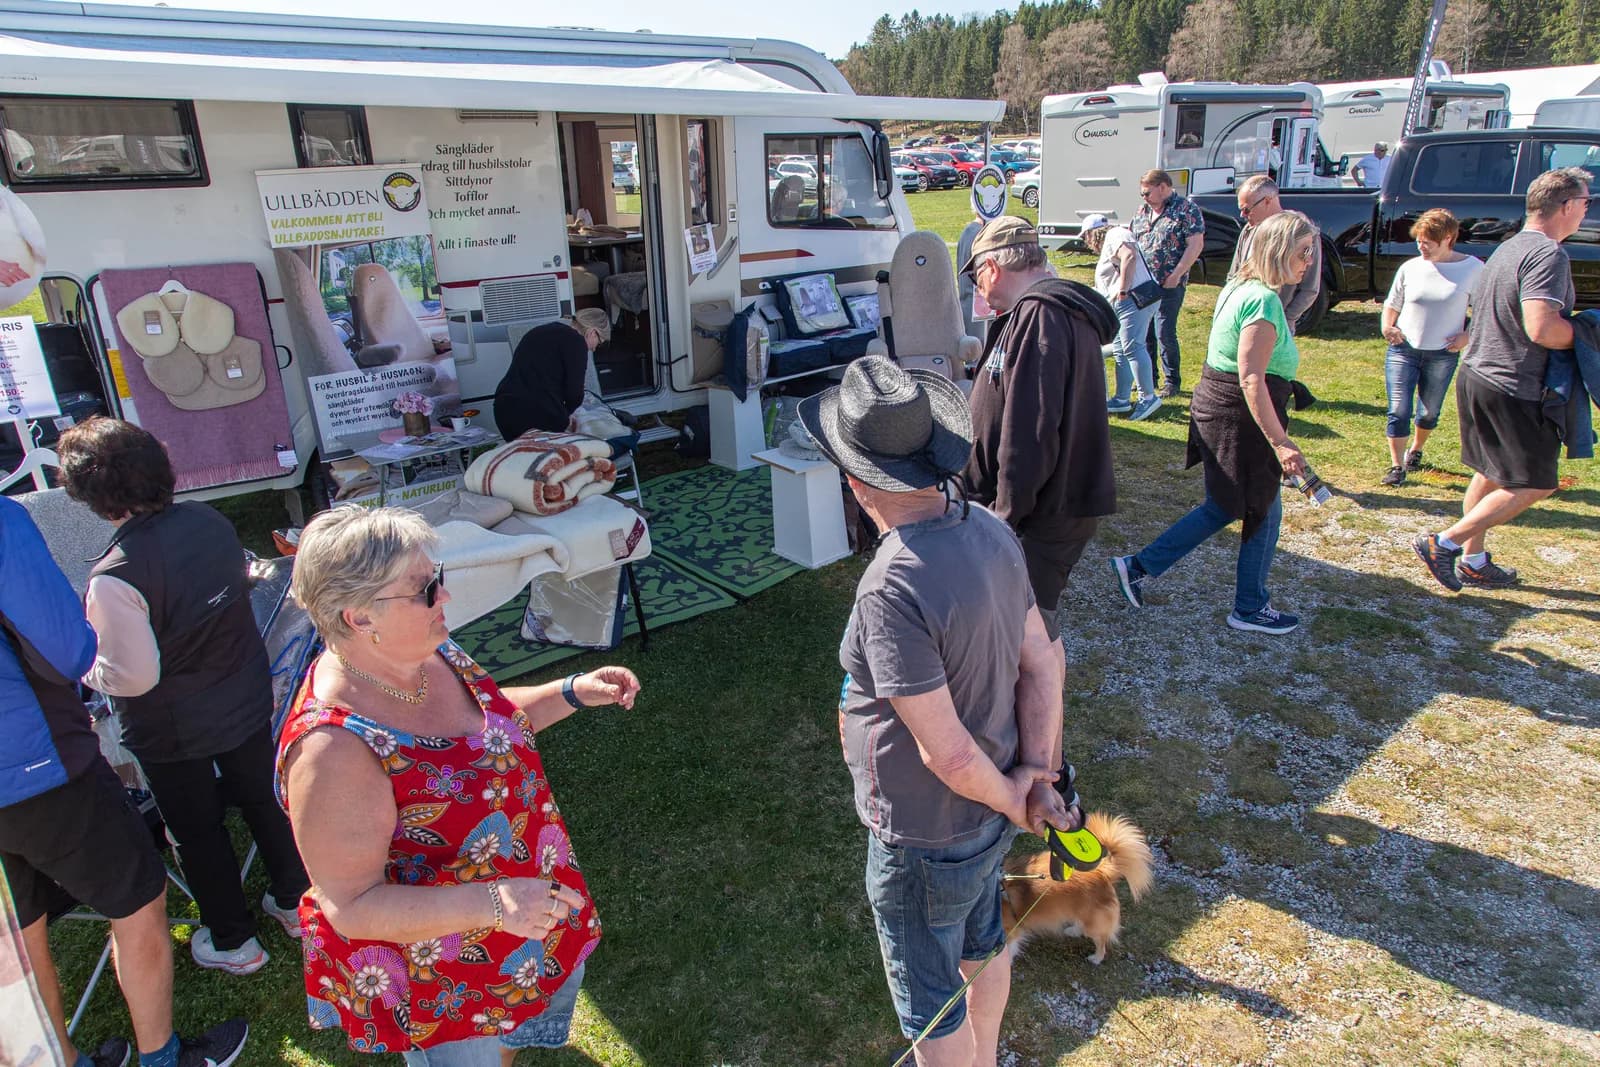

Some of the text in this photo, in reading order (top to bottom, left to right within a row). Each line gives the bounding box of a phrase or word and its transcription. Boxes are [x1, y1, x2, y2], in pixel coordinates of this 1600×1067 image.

[1083, 129, 1118, 138] CHAUSSON
[435, 142, 494, 157] Sängkläder
[421, 157, 532, 173] rdrag till husbilsstolar
[445, 176, 493, 189] Sittdynor
[265, 186, 380, 211] ULLBÄDDEN
[454, 191, 489, 202] Tofflor
[345, 212, 366, 224] ATT
[367, 211, 384, 223] BLI
[449, 207, 485, 221] mycket
[437, 239, 455, 250] Allt
[465, 236, 499, 248] finaste
[501, 234, 516, 246] ull!
[0, 322, 23, 332] RIS
[335, 375, 368, 388] HUSBIL
